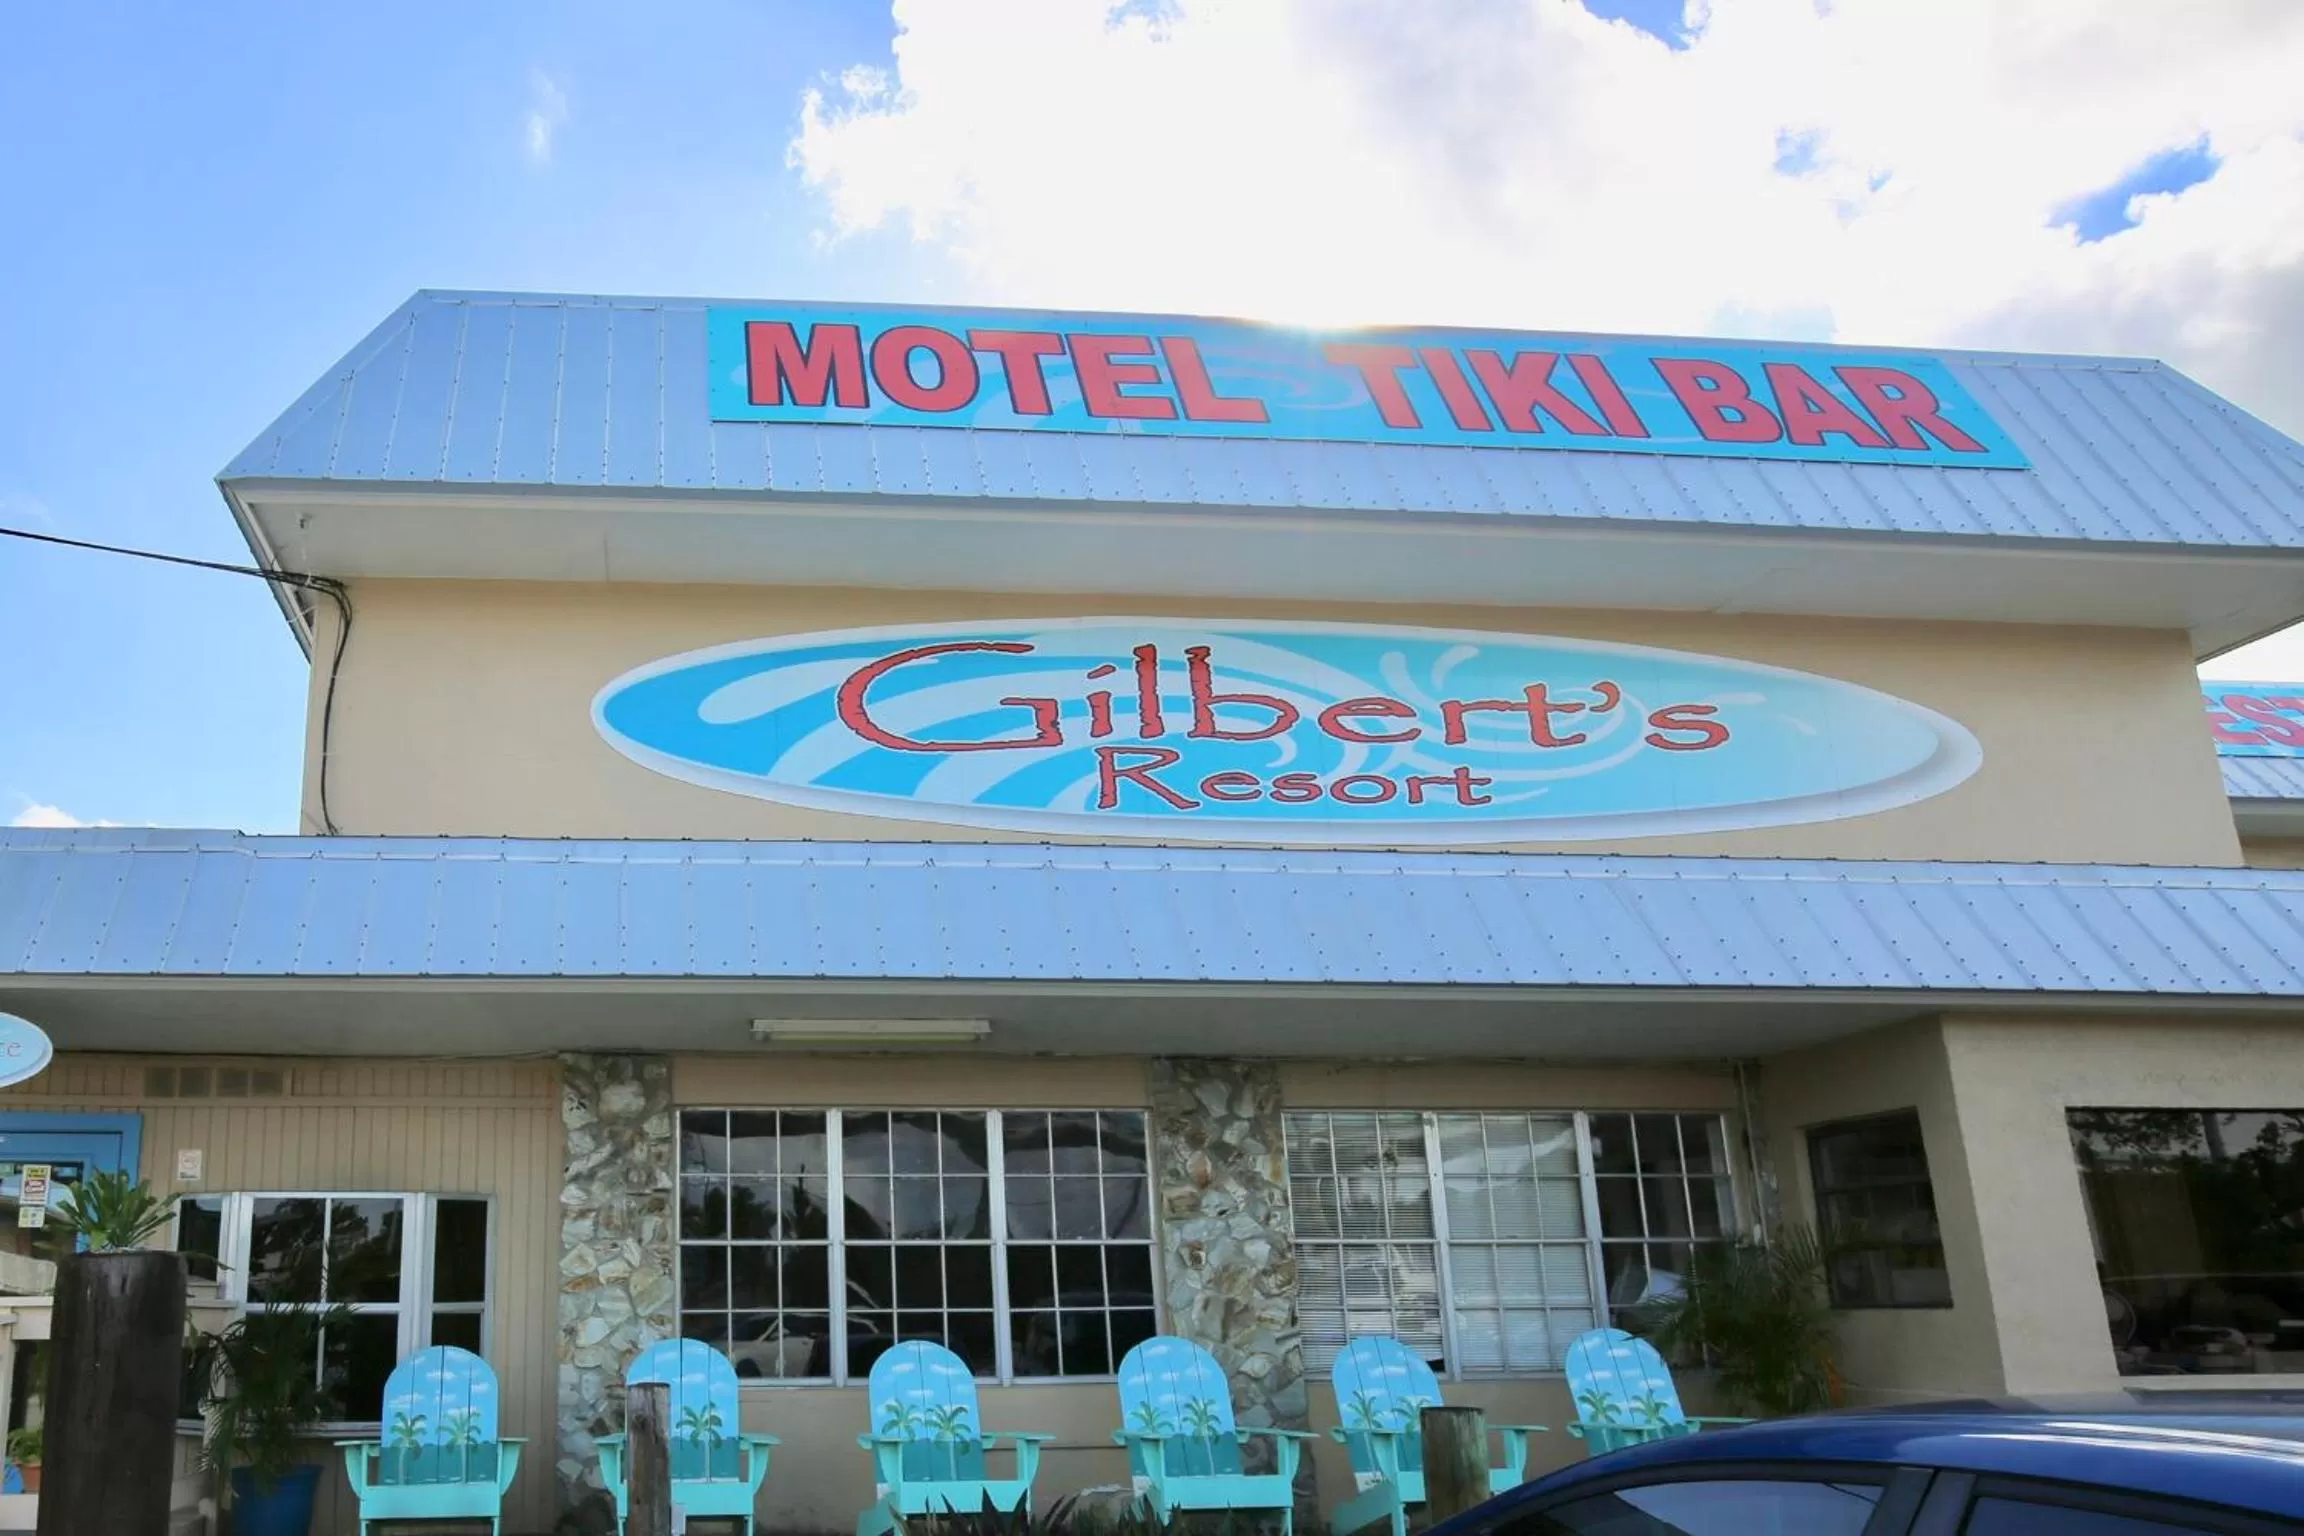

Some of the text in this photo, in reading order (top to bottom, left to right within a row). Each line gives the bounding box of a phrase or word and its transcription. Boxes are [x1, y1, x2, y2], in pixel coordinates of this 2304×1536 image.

[744, 320, 1989, 452] MOTEL TIKI BAR
[837, 643, 1731, 751] Gilbert's
[1098, 746, 1493, 809] Resort
